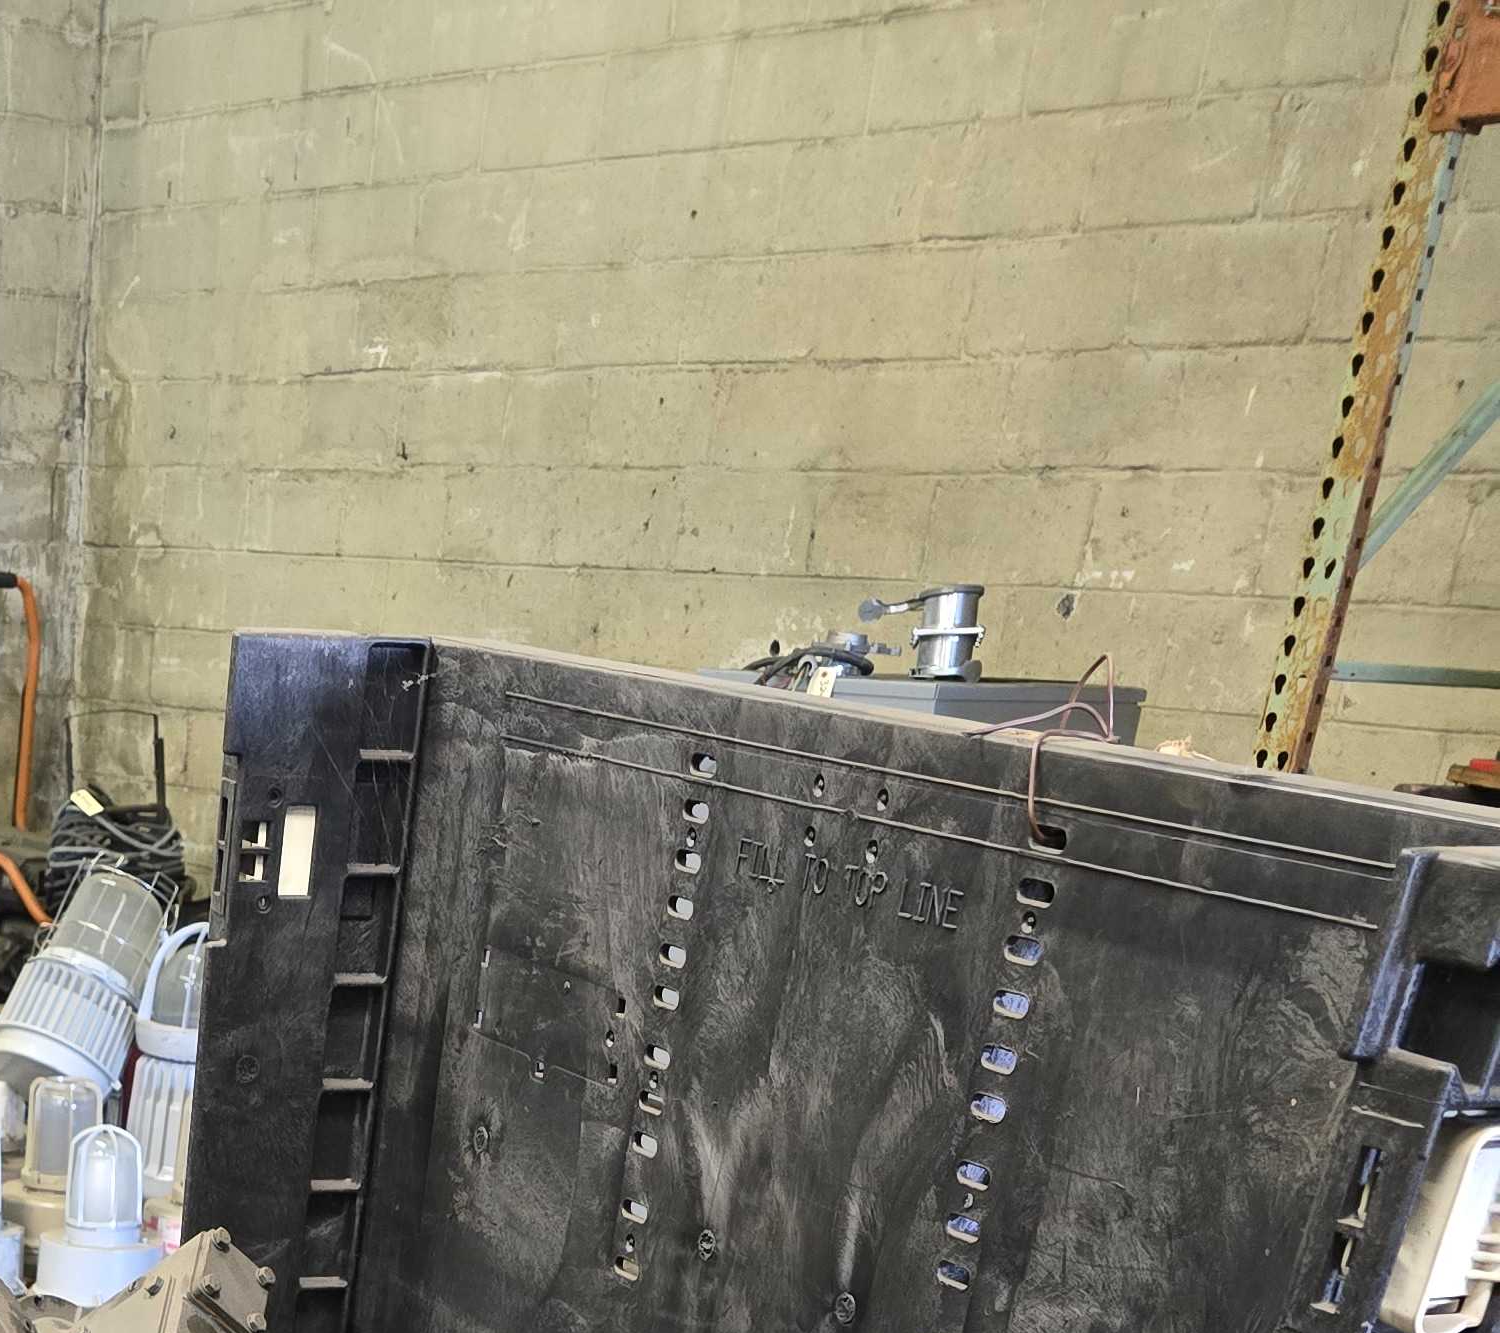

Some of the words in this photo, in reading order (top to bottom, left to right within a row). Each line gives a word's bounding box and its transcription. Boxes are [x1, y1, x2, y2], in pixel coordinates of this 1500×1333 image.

[735, 838, 785, 886] FILL
[803, 852, 829, 894] TO
[845, 864, 889, 908] TOP
[898, 876, 964, 930] LINE
